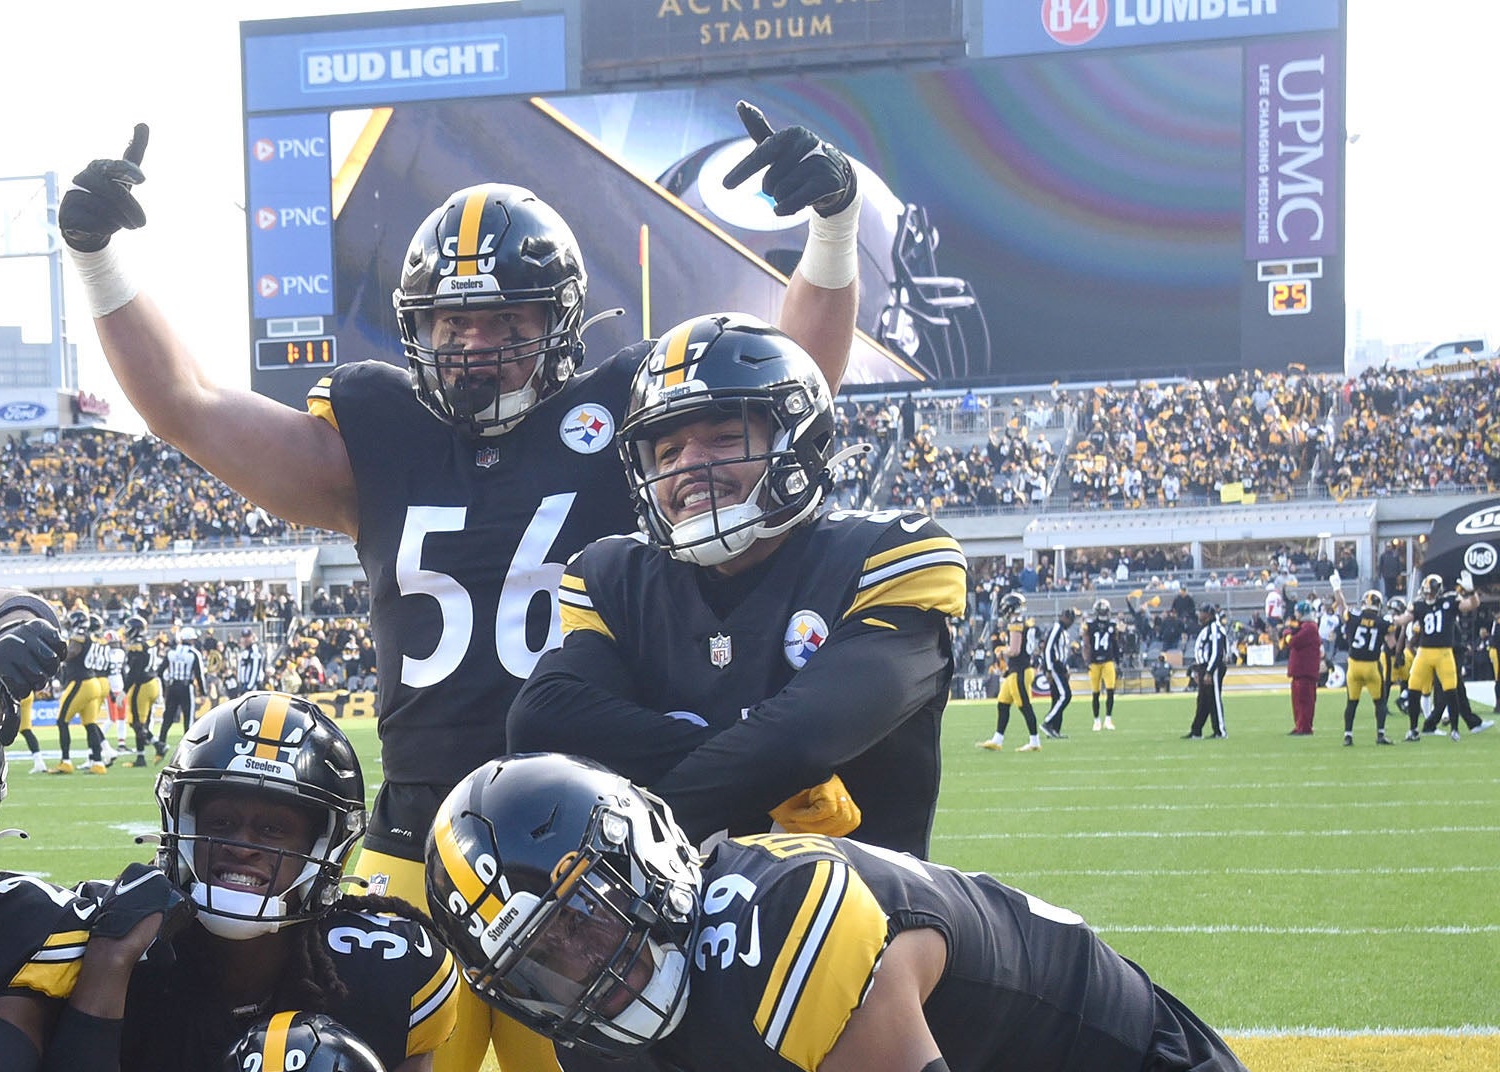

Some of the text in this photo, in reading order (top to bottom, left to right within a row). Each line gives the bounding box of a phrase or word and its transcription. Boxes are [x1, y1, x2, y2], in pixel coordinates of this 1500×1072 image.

[700, 15, 833, 44] STADIUM
[1049, 0, 1099, 32] 84
[308, 43, 500, 84] BUD LIGHT
[278, 137, 325, 159] PNC
[1258, 64, 1270, 244] LIFE CHANGING MEDICINE
[1276, 54, 1325, 243] UPMC
[280, 206, 327, 228] PNC
[440, 234, 496, 276] 56
[282, 274, 329, 296] PNC
[450, 276, 484, 290] Steelers
[1273, 284, 1307, 311] 25
[564, 425, 585, 435] Steelers
[396, 492, 577, 688] 56
[1424, 610, 1443, 635] 81
[1093, 632, 1110, 651] 14
[1352, 626, 1379, 651] 51
[235, 719, 303, 764] 34
[244, 758, 282, 774] Steelers
[487, 906, 520, 942] Steelers
[695, 873, 757, 972] 39
